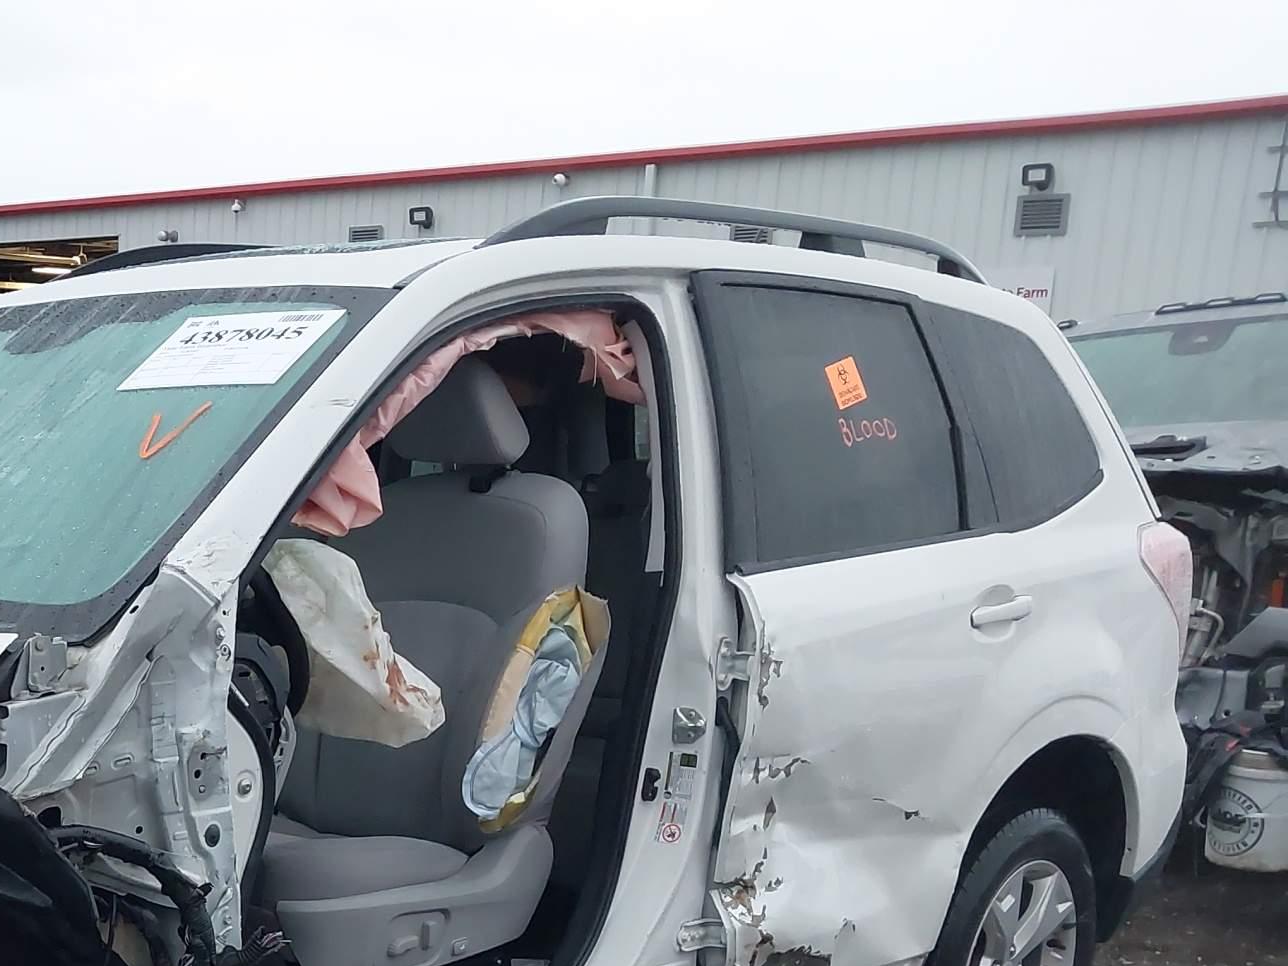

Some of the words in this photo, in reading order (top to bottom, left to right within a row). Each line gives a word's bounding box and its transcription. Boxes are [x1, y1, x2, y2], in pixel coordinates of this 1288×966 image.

[1016, 287, 1049, 300] Farm
[179, 325, 309, 345] 43878045
[838, 417, 897, 447] BLOOD
